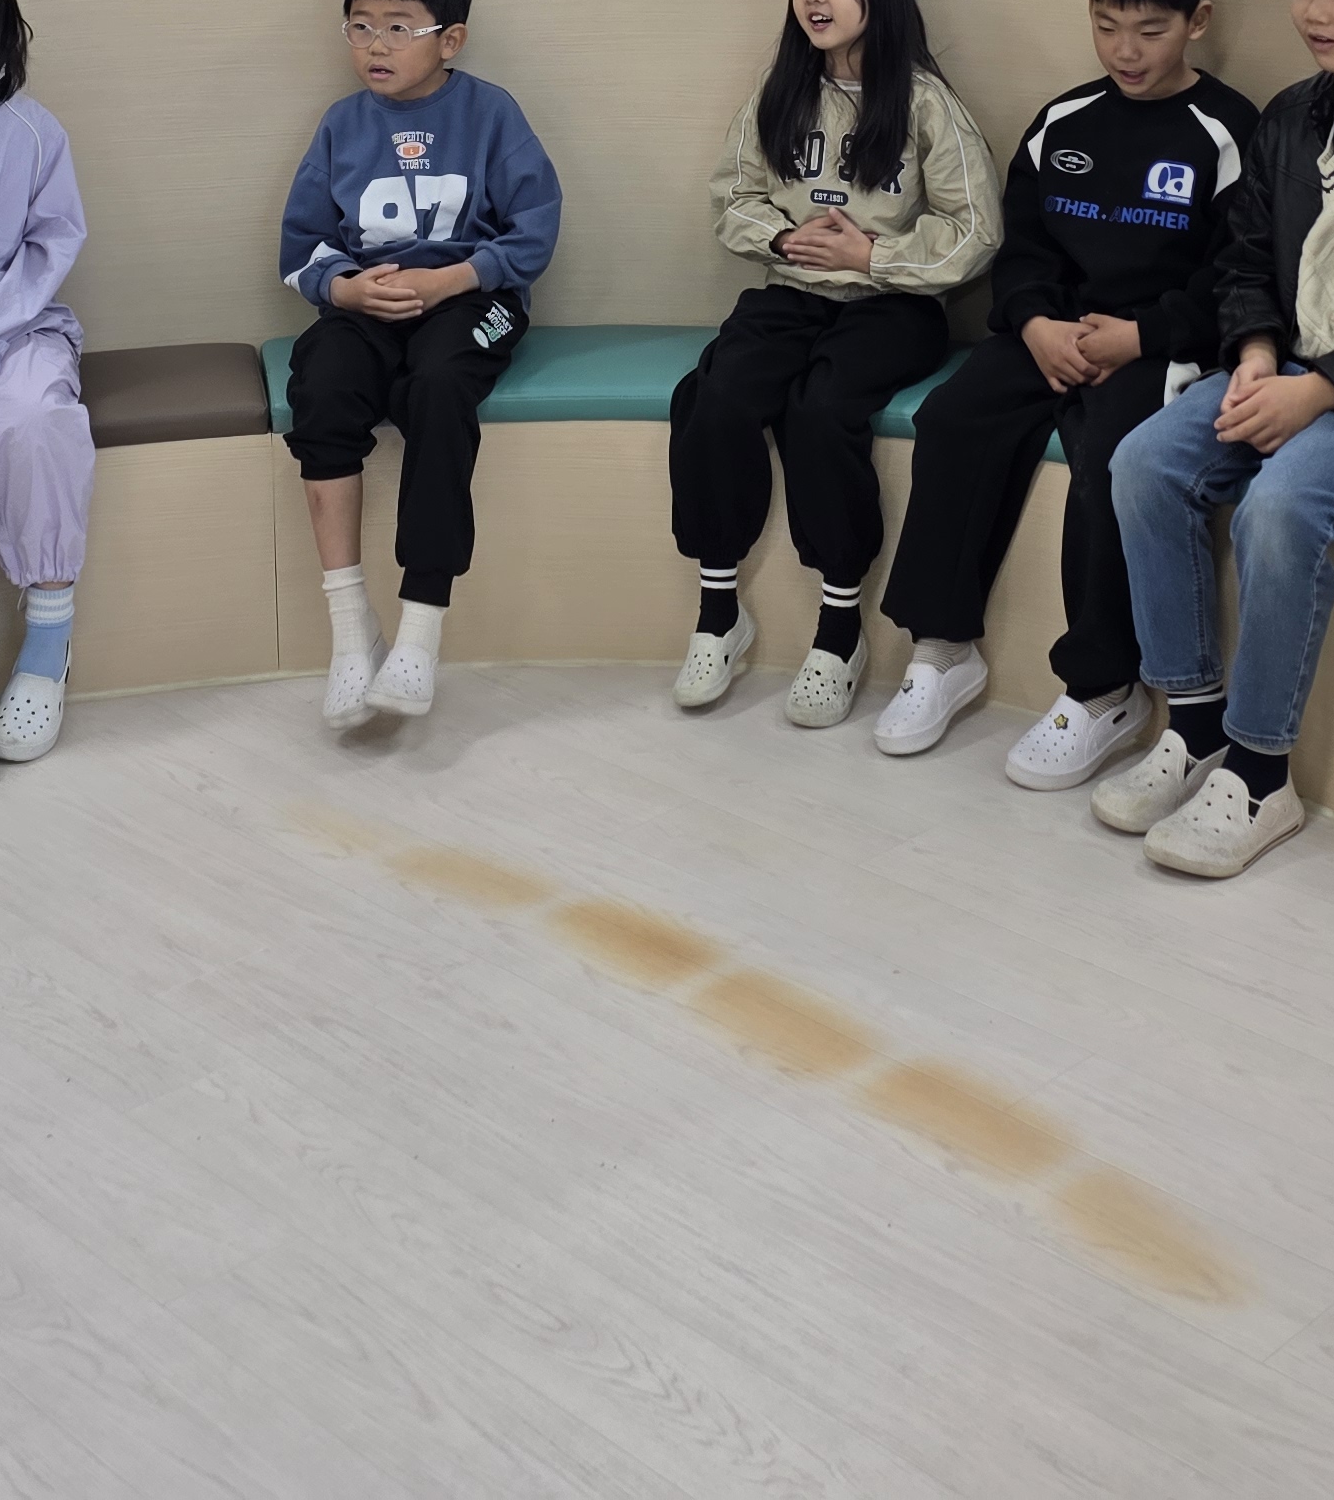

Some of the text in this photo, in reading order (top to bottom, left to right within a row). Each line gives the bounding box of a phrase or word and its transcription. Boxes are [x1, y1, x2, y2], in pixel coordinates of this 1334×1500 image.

[398, 158, 430, 170] CTORY'S
[1044, 195, 1190, 231] OTHER ANOTHER
[486, 312, 508, 336] MOUSE
